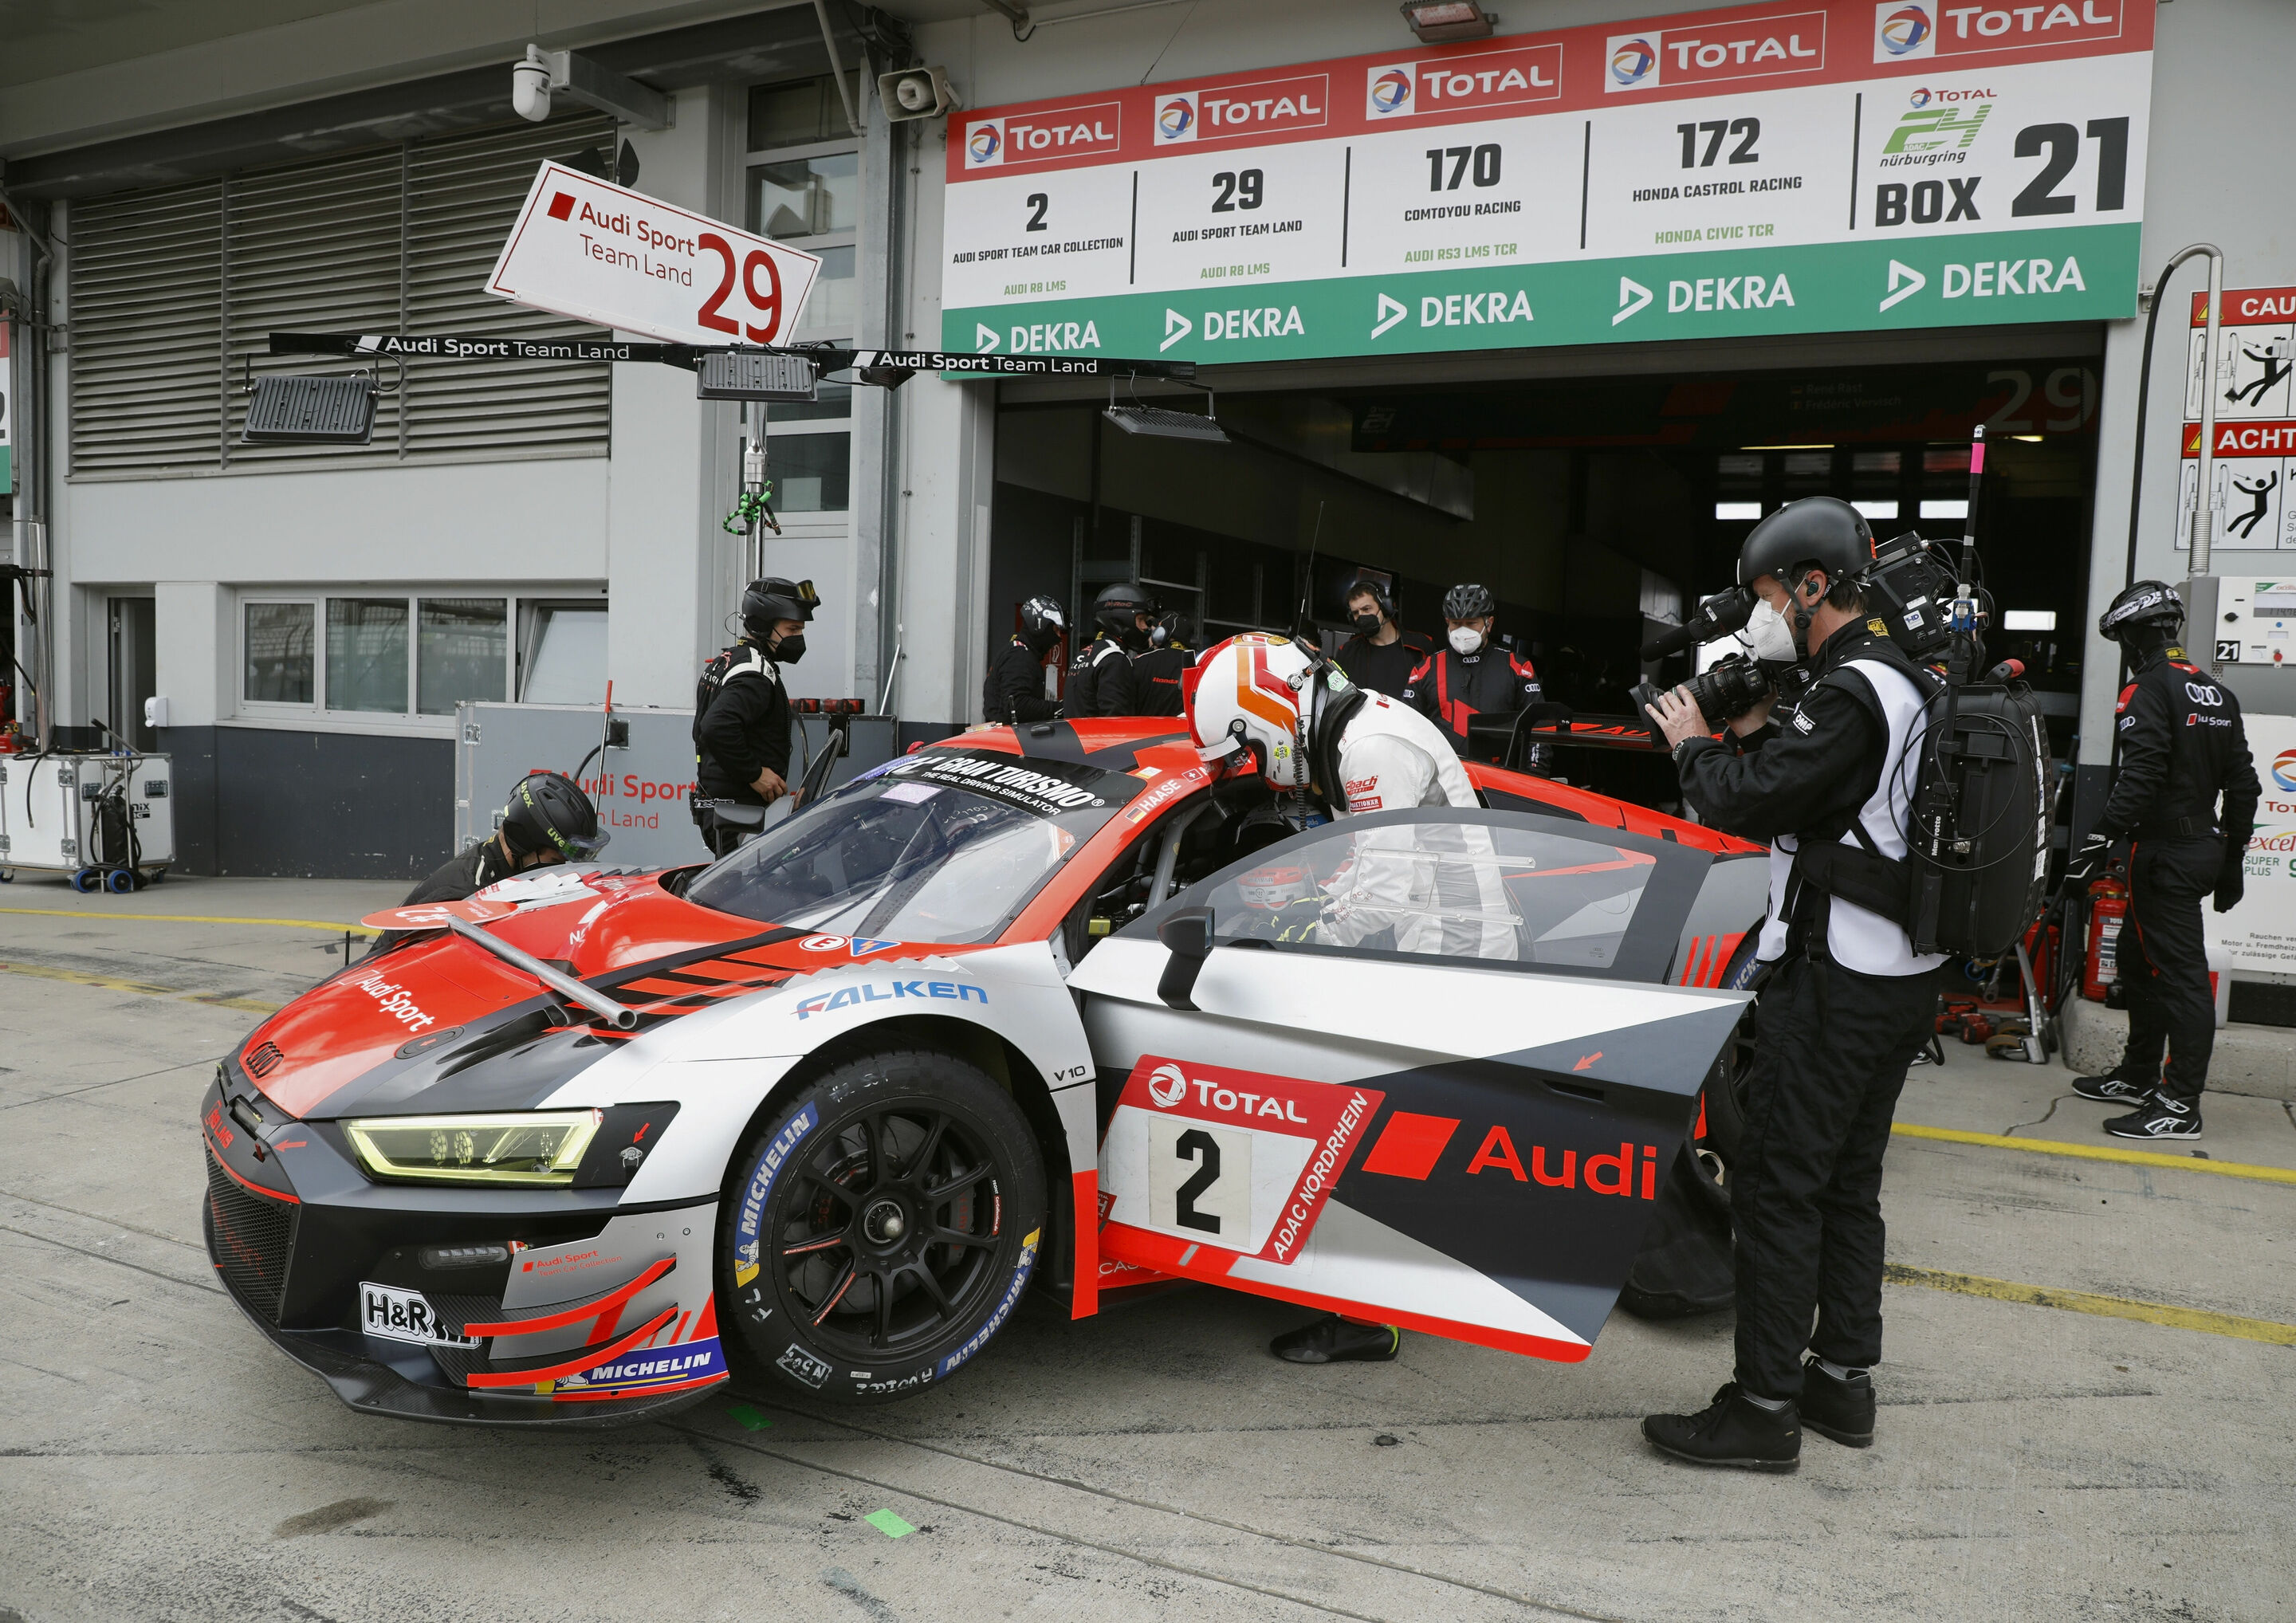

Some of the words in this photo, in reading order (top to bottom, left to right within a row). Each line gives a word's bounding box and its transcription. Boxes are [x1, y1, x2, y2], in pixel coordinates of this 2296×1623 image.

[1945, 0, 2113, 39] TOTAL
[1668, 34, 1816, 70] TOTAL
[1422, 66, 1554, 99] TOTAL
[1935, 88, 1997, 102] TOTAL
[1204, 95, 1321, 126] TOTAL
[1009, 121, 1114, 150] TOTAL
[1677, 117, 1760, 169] 172
[1904, 143, 1924, 151] ADAC
[1426, 143, 1502, 192] 170
[1880, 151, 1966, 167] nürburgring
[2011, 116, 2129, 218] 21
[1212, 169, 1264, 213] 29
[1633, 187, 1680, 202] HONDA
[1684, 181, 1745, 198] CASTROL
[1750, 176, 1803, 192] RACING
[1876, 176, 1982, 227] BOX
[1026, 193, 1048, 232] 2
[1405, 205, 1471, 222] COMTOYOU
[1475, 201, 1521, 216] RACING
[580, 202, 630, 238] Audi
[637, 220, 695, 257] Sport
[1173, 230, 1198, 242] AUDI
[1201, 226, 1236, 240] SPORT
[1240, 223, 1270, 237] TEAM
[1273, 220, 1303, 234] LAND
[1655, 229, 1702, 244] HONDA
[1706, 226, 1744, 241] CIVIC
[1748, 224, 1775, 238] TCR
[580, 234, 639, 272] Team
[645, 253, 692, 288] Land
[953, 250, 976, 264] AUDI
[978, 248, 1008, 261] SPORT
[1012, 246, 1038, 258] TEAM
[1040, 244, 1060, 255] CAR
[1063, 238, 1123, 253] COLLECTION
[1405, 250, 1433, 263] AUDI
[1437, 248, 1461, 261] RS3
[1464, 246, 1490, 258] LMS
[1494, 243, 1518, 256] TCR
[1201, 267, 1226, 279] AUDI
[1229, 265, 1244, 277] R8
[1248, 263, 1270, 275] LMS
[1942, 256, 2086, 298] DEKRA
[698, 233, 782, 343] 29
[1004, 283, 1027, 295] AUDI
[1030, 282, 1043, 293] R8
[1046, 281, 1066, 292] LMS
[1668, 273, 1795, 312] DEKRA
[1204, 305, 1305, 340] DEKRA
[1421, 290, 1534, 328] DEKRA
[2241, 297, 2296, 316] CAU
[384, 337, 438, 354] Audi
[445, 338, 509, 357] Sport
[513, 341, 571, 359] Team
[578, 344, 630, 360] Land
[1011, 320, 1101, 353] DEKRA
[879, 351, 926, 367] Audi
[932, 353, 989, 371] Sport
[993, 356, 1046, 372] Team
[1052, 358, 1097, 374] Land
[1805, 383, 1835, 395] René
[1837, 382, 1863, 394] Rast
[1805, 399, 1852, 411] Frédéric
[1854, 395, 1901, 409] Vervisch
[1986, 367, 2097, 432] 29
[2218, 428, 2296, 450] ACHT
[2217, 643, 2239, 660] 21
[1795, 713, 1814, 730] OMP
[521, 781, 535, 808] uvex
[623, 774, 698, 804] Sport
[932, 757, 1003, 776] GRAN
[983, 766, 1095, 808] TURISMO
[937, 773, 961, 783] REAL
[960, 778, 1001, 792] DRIVING
[999, 788, 1062, 816] SIMULATOR
[1138, 779, 1181, 812] HAASE
[611, 809, 659, 830] Land
[1932, 815, 1941, 856] Manrotto
[547, 827, 567, 847] uve
[2244, 855, 2280, 867] SUPER
[2244, 867, 2271, 876] PLUS
[355, 975, 402, 999] Audi
[379, 991, 435, 1032] Sport
[792, 980, 989, 1020] FALKEN
[1054, 1065, 1087, 1083] V10
[1193, 1079, 1307, 1124] TOTAL
[741, 1112, 811, 1236] MICHELIN
[1275, 1204, 1307, 1260] ADAC
[1299, 1091, 1369, 1206] NORDRHEIN
[1466, 1125, 1657, 1201] Audi
[1176, 1129, 1221, 1235] 2
[537, 1256, 563, 1268] Audi
[564, 1250, 599, 1263] Sport
[538, 1267, 561, 1277] Team
[579, 1256, 622, 1270] Collection
[368, 1292, 429, 1334] H&R
[946, 1272, 1026, 1372] MICHELIN
[592, 1352, 712, 1380] MICHELIN
